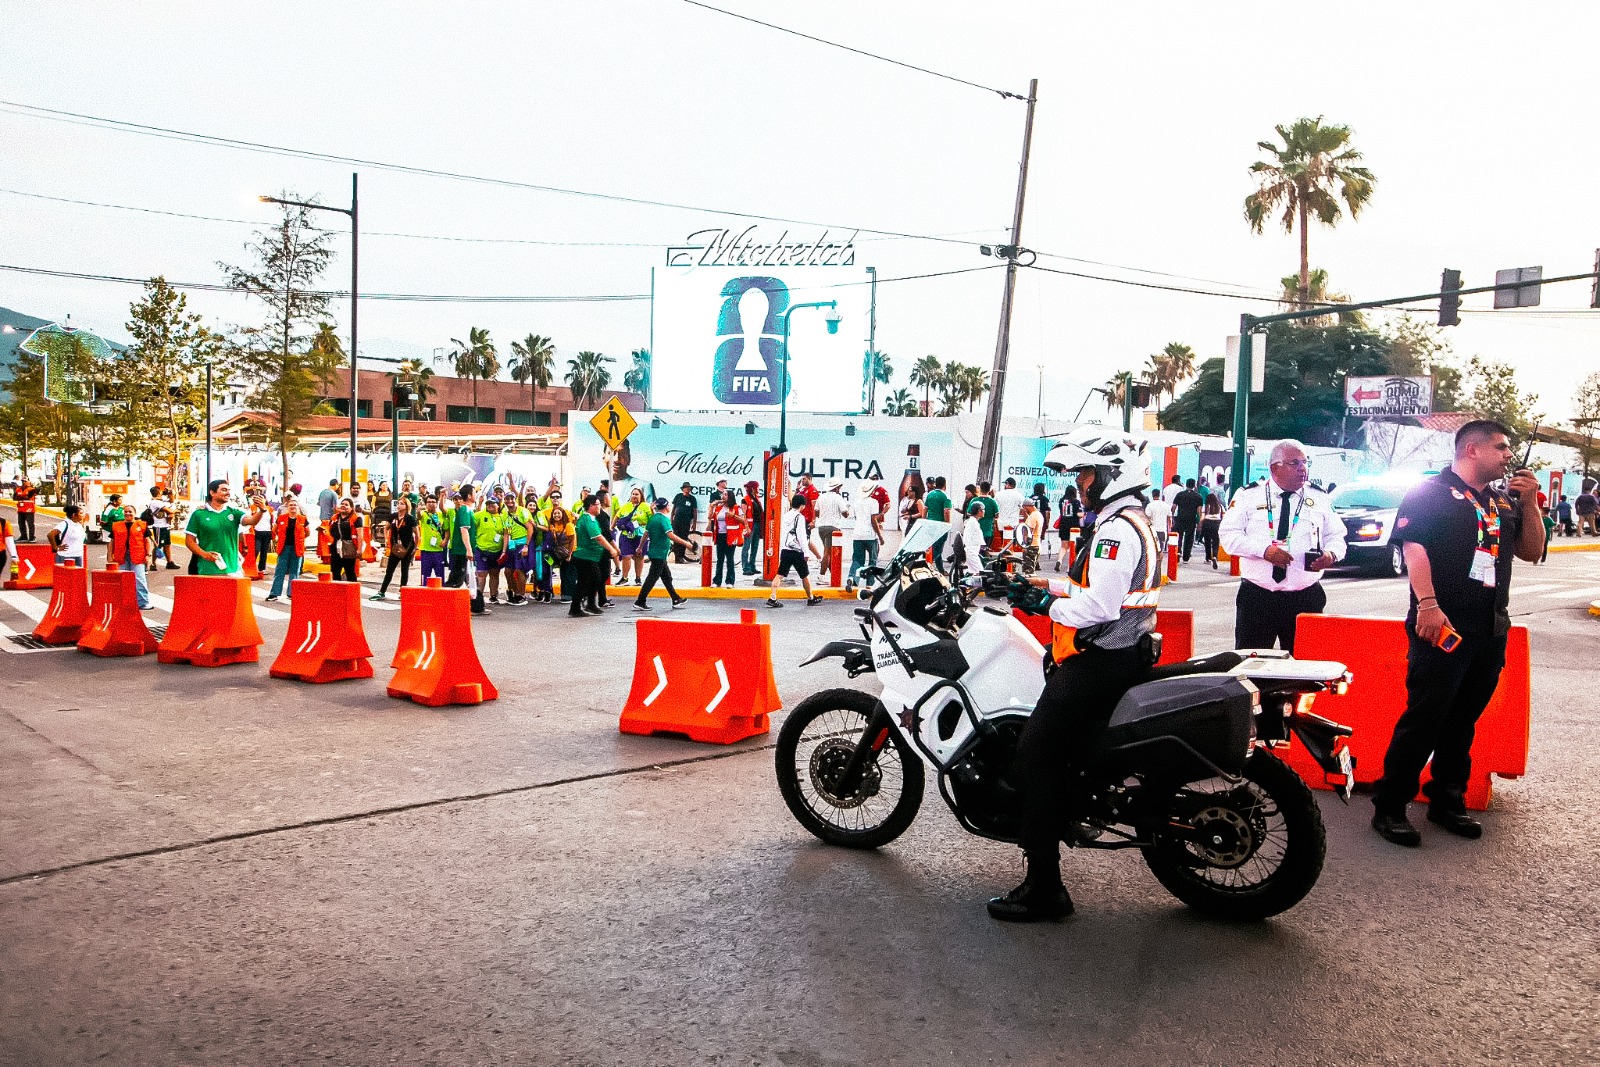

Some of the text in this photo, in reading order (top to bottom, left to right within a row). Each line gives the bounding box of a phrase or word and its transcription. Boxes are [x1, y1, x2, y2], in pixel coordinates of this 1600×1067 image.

[670, 225, 859, 276] Michelob
[732, 376, 771, 392] FIFA
[1348, 405, 1429, 415] ESTACIONAMIENTO
[656, 449, 754, 476] Michelob
[788, 457, 884, 481] ULTRA
[1008, 466, 1048, 477] CERVEZA
